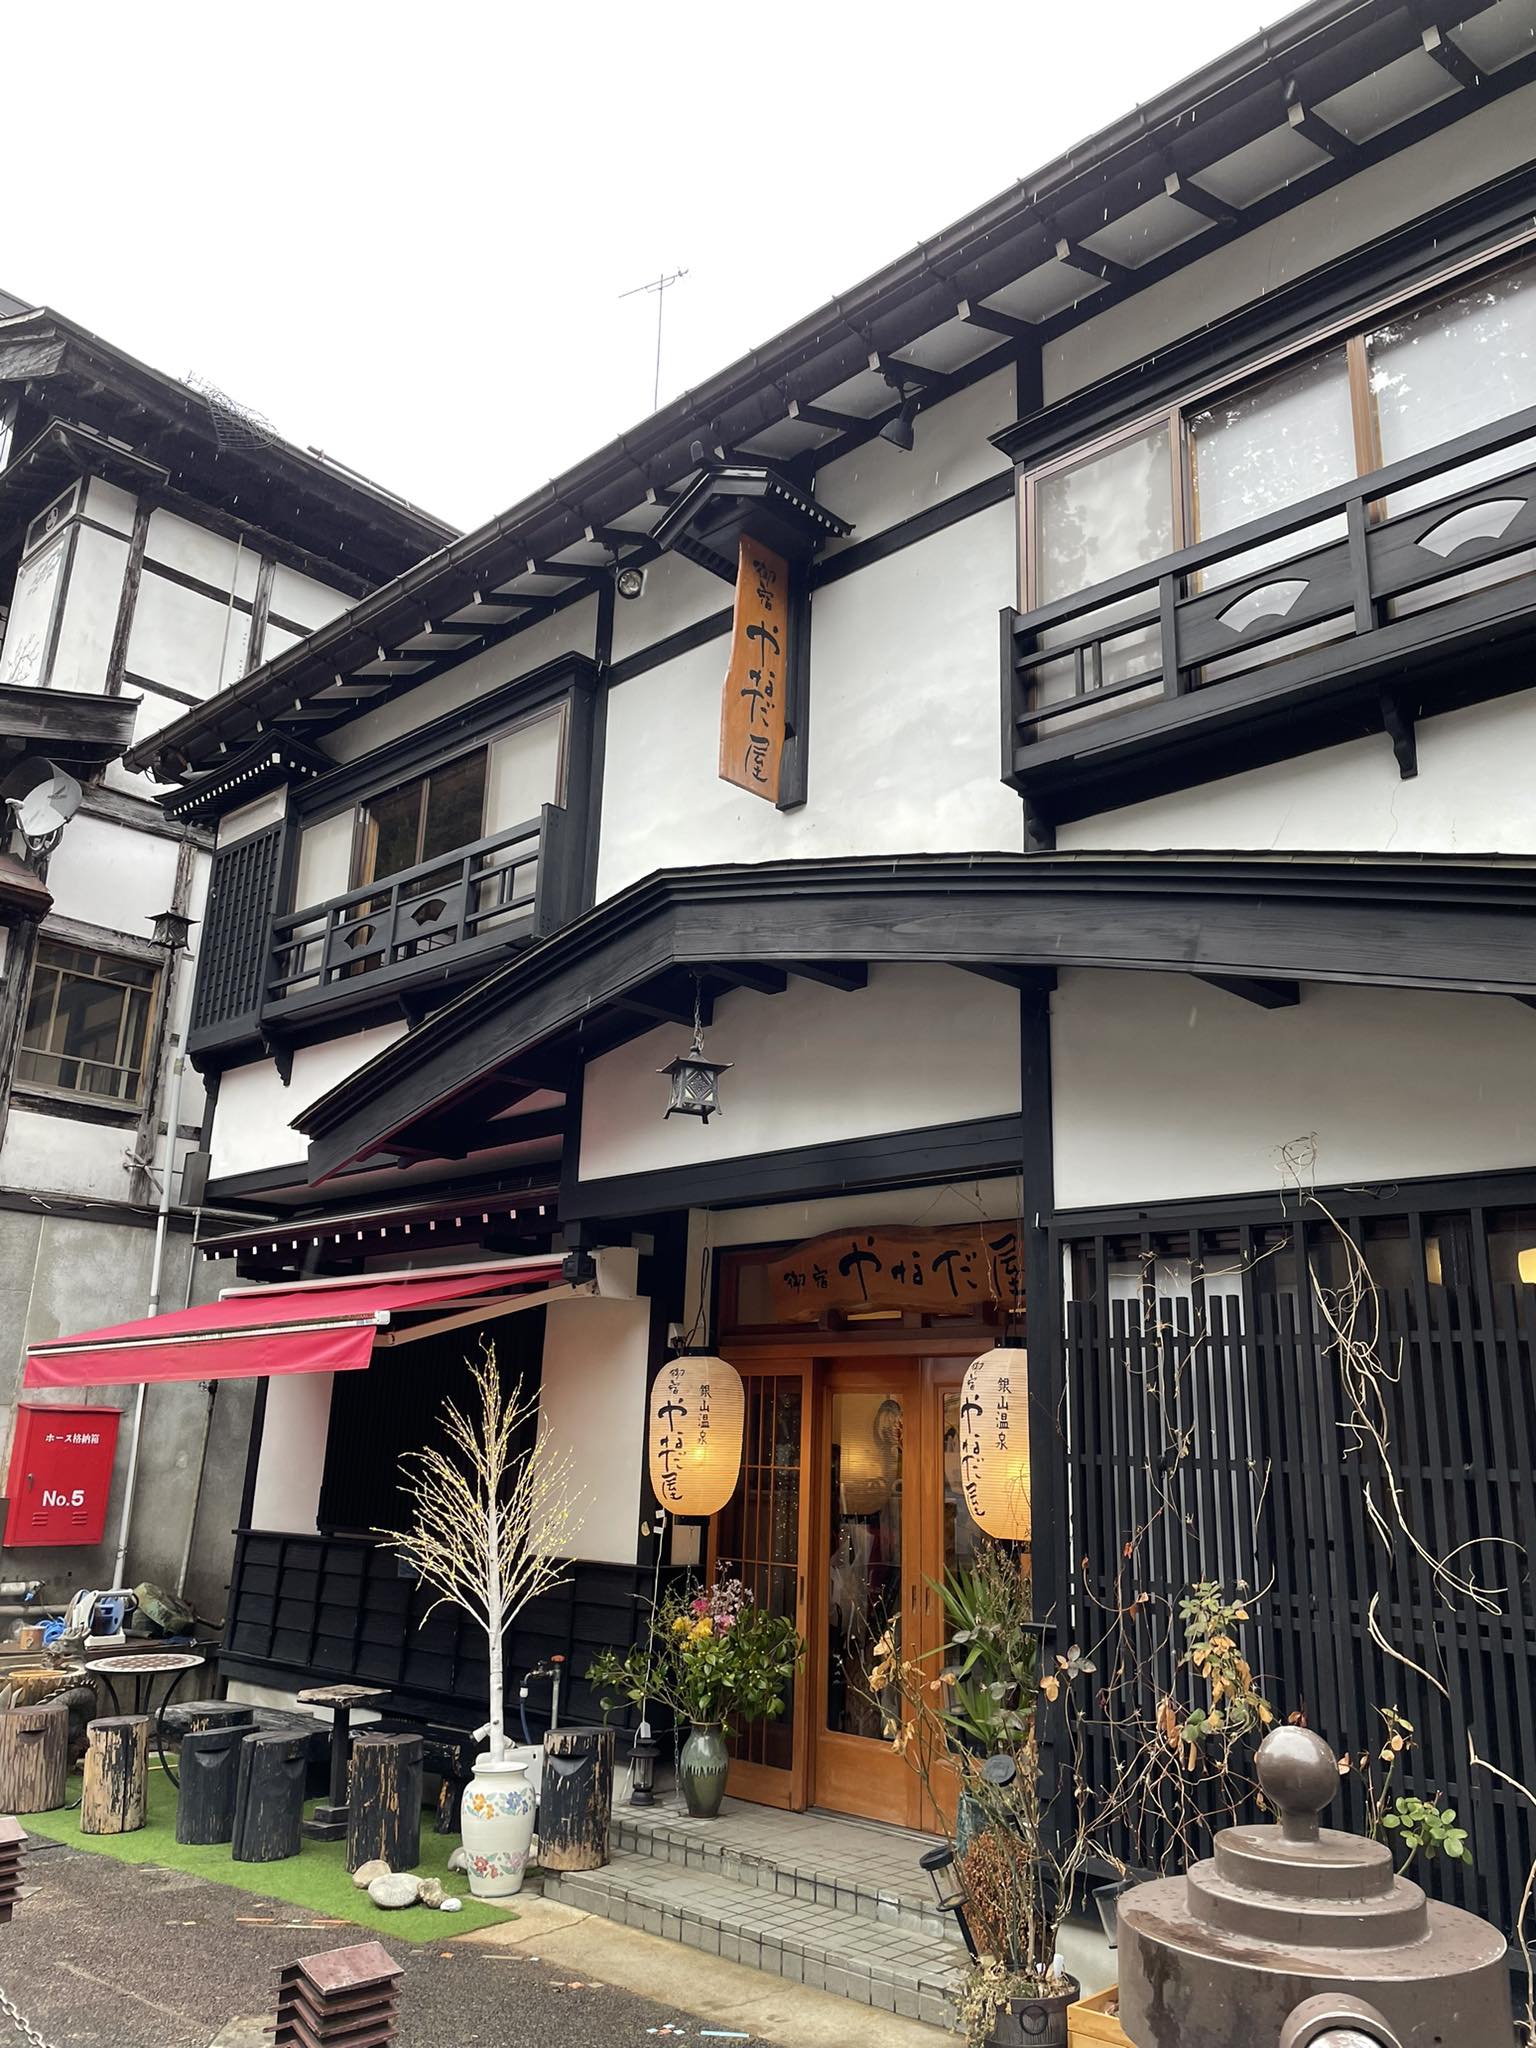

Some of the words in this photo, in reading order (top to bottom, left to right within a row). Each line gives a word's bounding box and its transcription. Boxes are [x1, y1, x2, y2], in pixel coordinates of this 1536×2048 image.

[838, 1232, 1027, 1301] やなだ屋
[45, 1433, 100, 1444] ホース格納箱
[697, 1384, 712, 1445] 銀山温泉
[995, 1376, 1012, 1451] 銀山温泉
[41, 1489, 85, 1507] No.5
